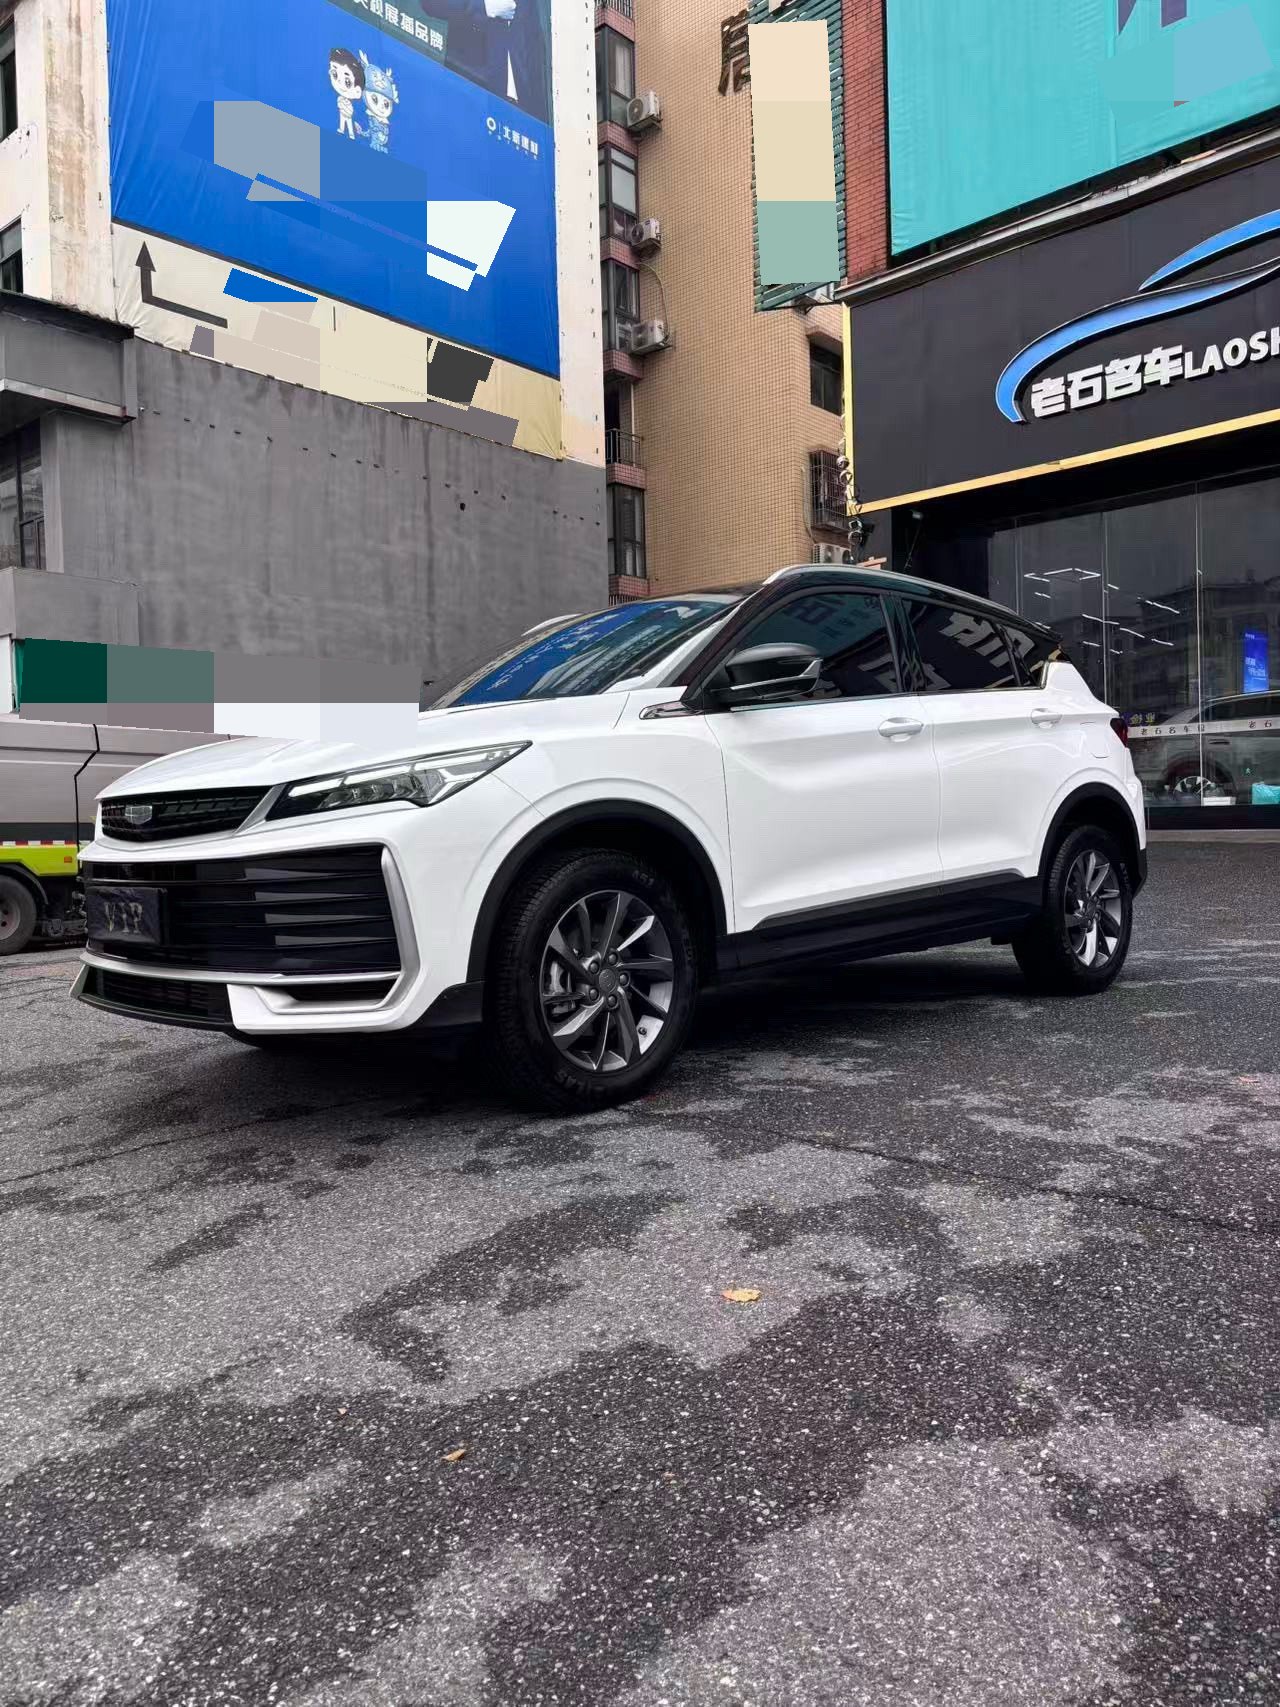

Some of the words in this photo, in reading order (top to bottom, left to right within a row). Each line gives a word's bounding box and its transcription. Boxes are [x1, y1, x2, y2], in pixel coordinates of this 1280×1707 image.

[1031, 344, 1183, 418] 老石名车
[104, 902, 143, 933] VIP
